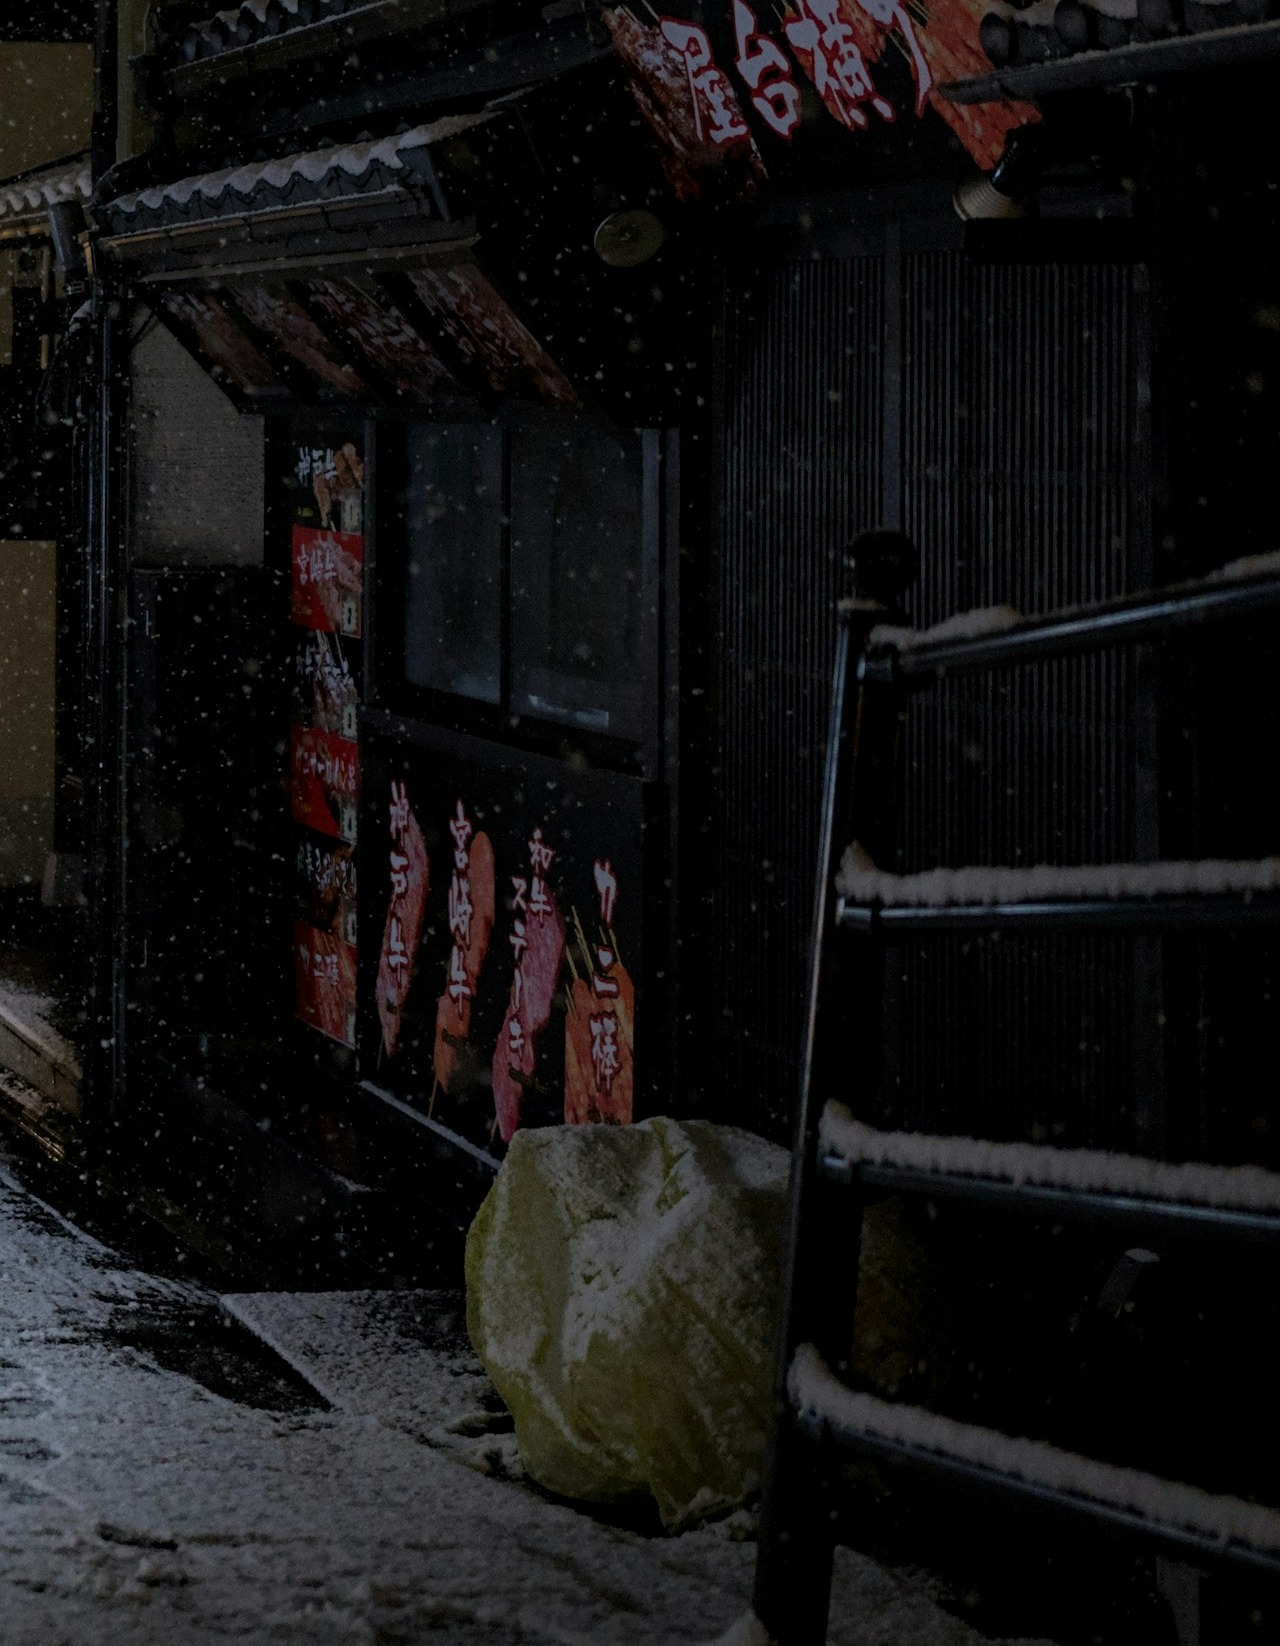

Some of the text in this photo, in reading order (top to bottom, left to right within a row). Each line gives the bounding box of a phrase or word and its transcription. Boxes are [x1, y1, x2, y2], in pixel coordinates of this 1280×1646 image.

[388, 778, 411, 990] 神戸牛
[508, 873, 529, 1063] ステーキ
[527, 826, 557, 928] 和牛
